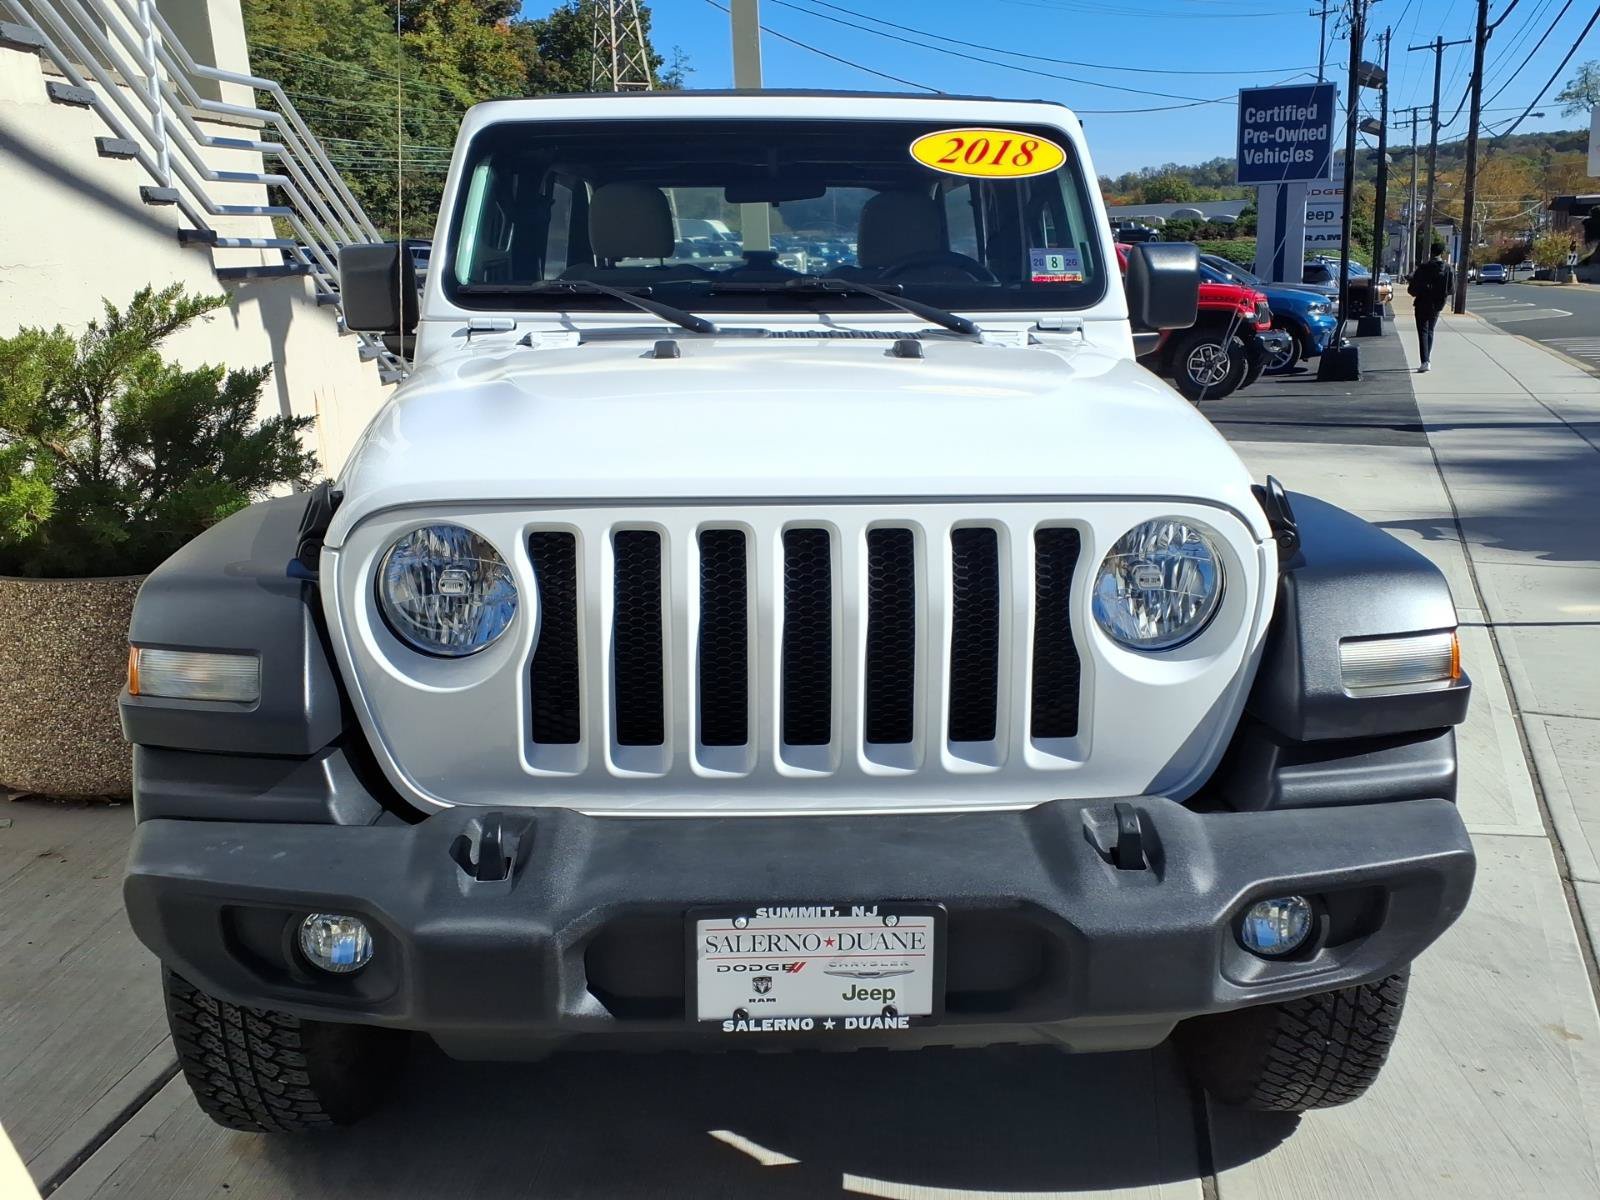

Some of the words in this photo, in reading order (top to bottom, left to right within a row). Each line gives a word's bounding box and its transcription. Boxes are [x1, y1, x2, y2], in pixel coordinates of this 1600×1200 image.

[1245, 104, 1317, 123] Certified
[1244, 124, 1327, 144] Pre-Owned
[937, 137, 1039, 167] 2018
[1244, 148, 1314, 165] Vehicles
[1306, 210, 1335, 223] eep
[1051, 256, 1058, 269] 8
[852, 905, 878, 917] NJ
[705, 933, 821, 954] SALERNO
[838, 931, 926, 951] DUANE
[716, 963, 795, 973] DODGE
[842, 984, 896, 1004] Jeep
[722, 1018, 814, 1032] SALERNO
[844, 1016, 910, 1030] DUANE
